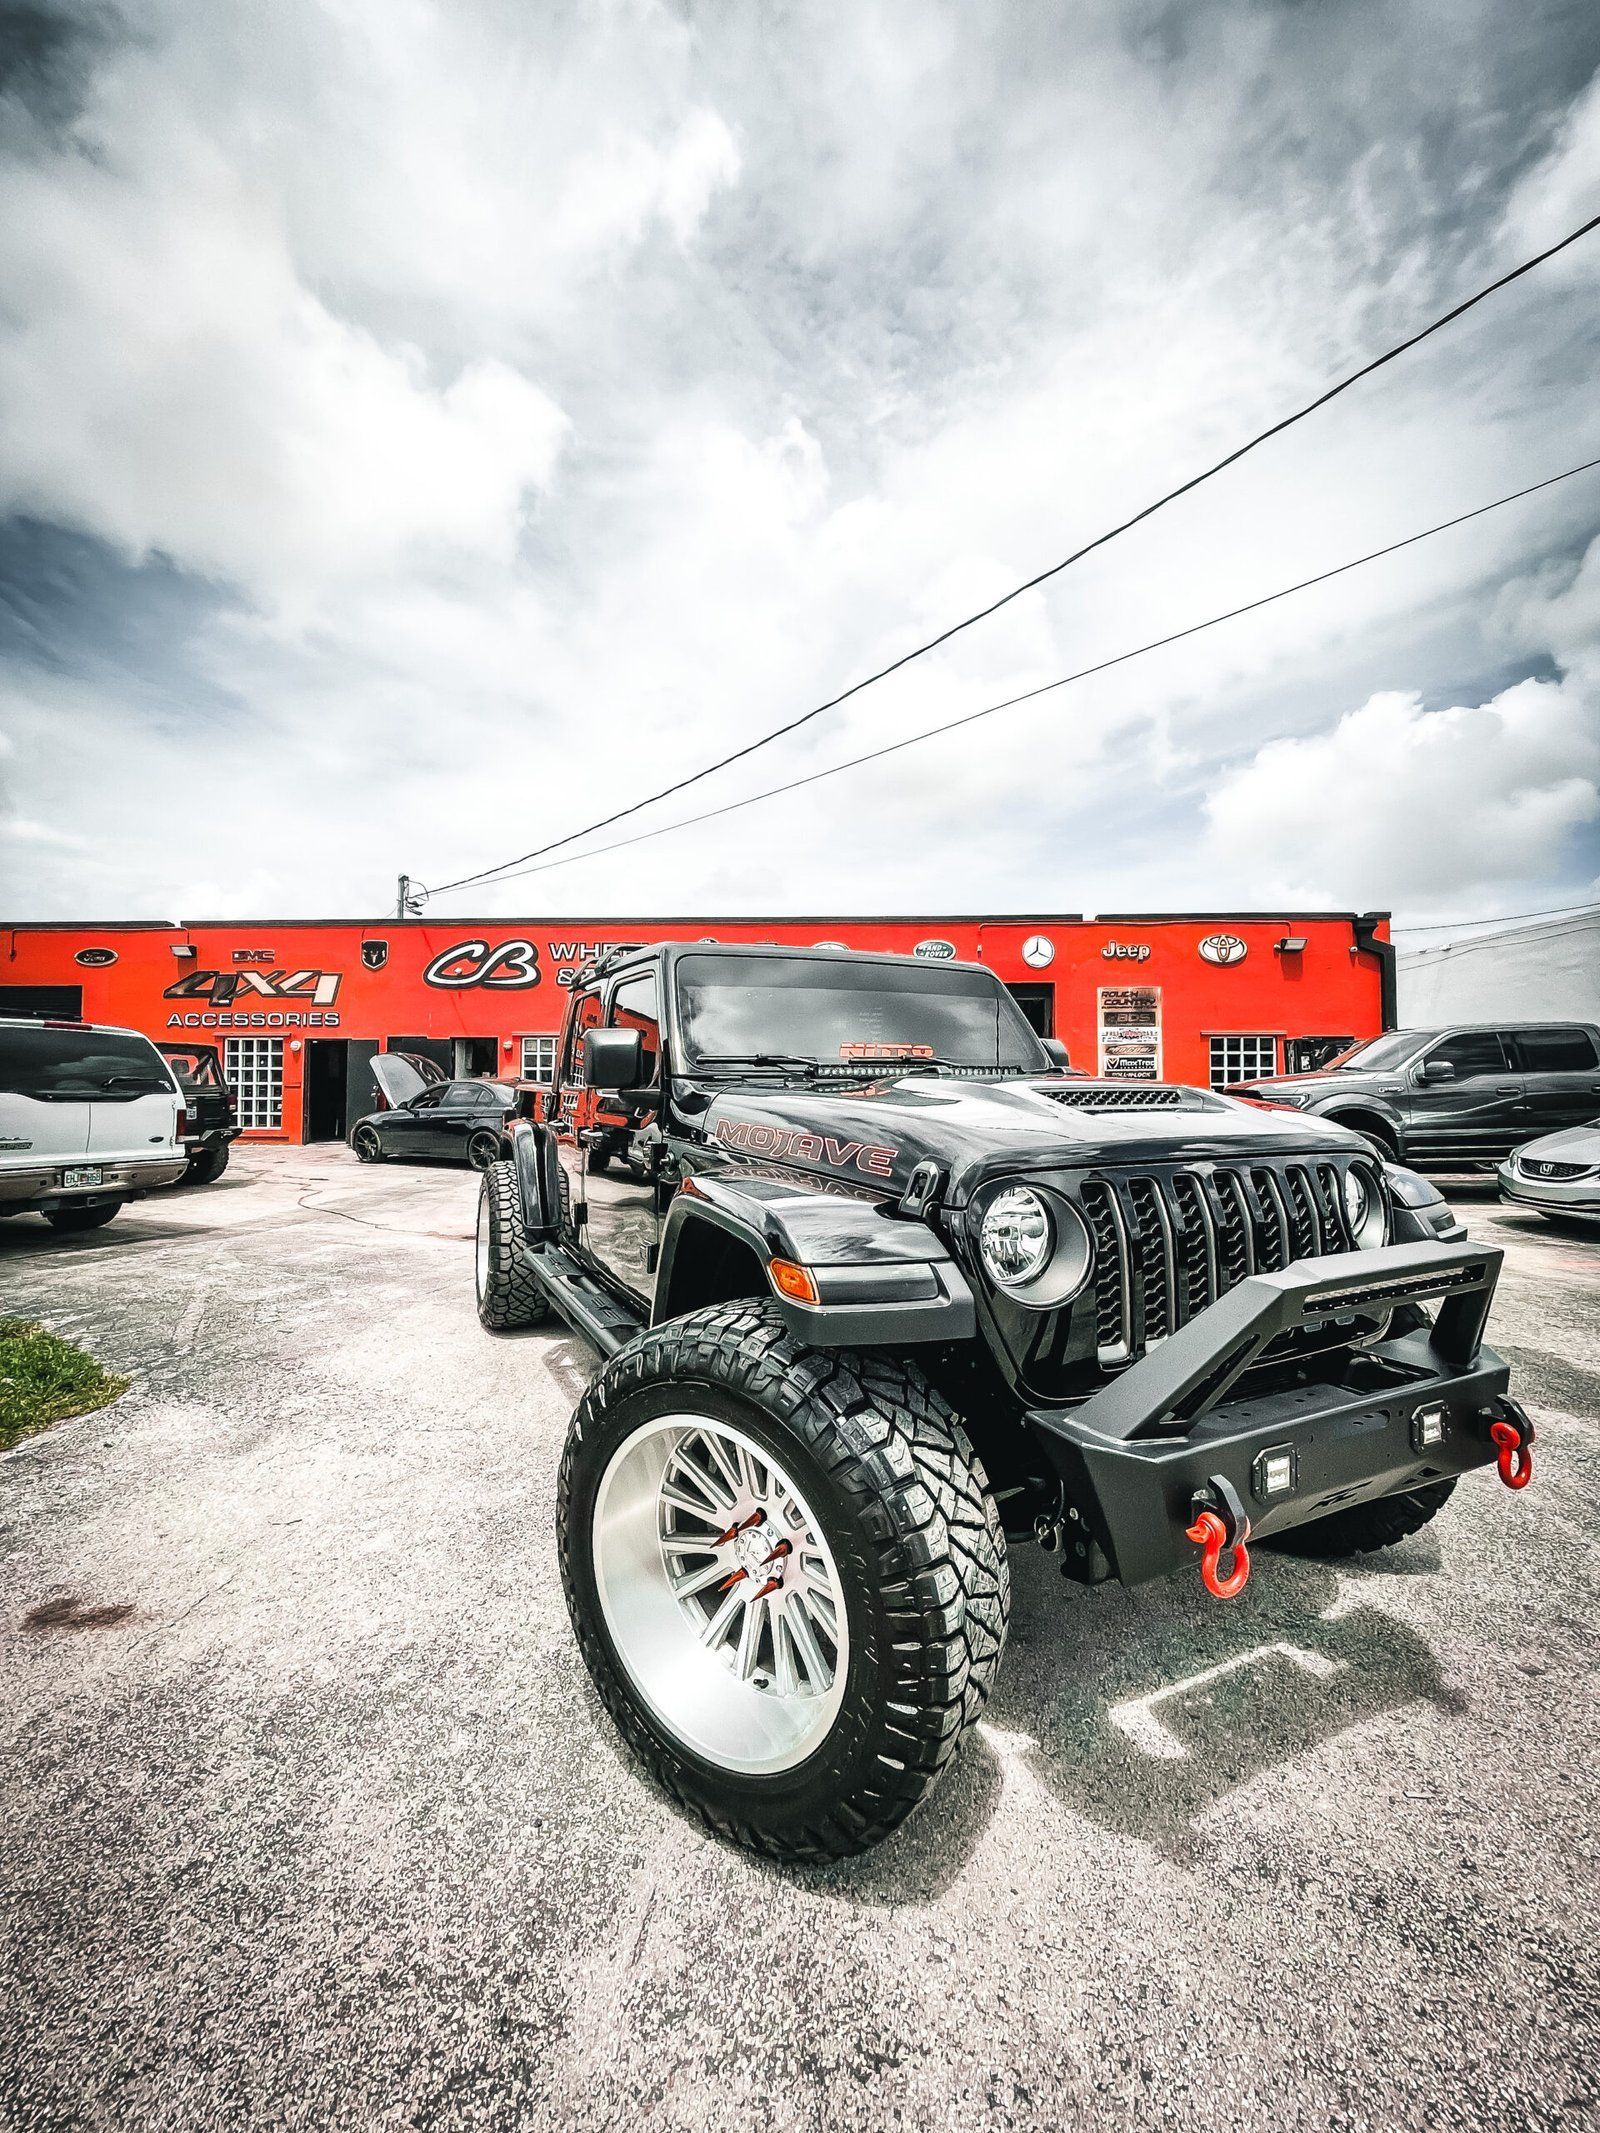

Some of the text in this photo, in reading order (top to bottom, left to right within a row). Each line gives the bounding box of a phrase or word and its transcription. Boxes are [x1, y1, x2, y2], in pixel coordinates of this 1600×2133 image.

[1102, 941, 1151, 962] Jeep
[166, 1012, 340, 1027] ACCESSORIES
[715, 1118, 899, 1177] MOJAVE
